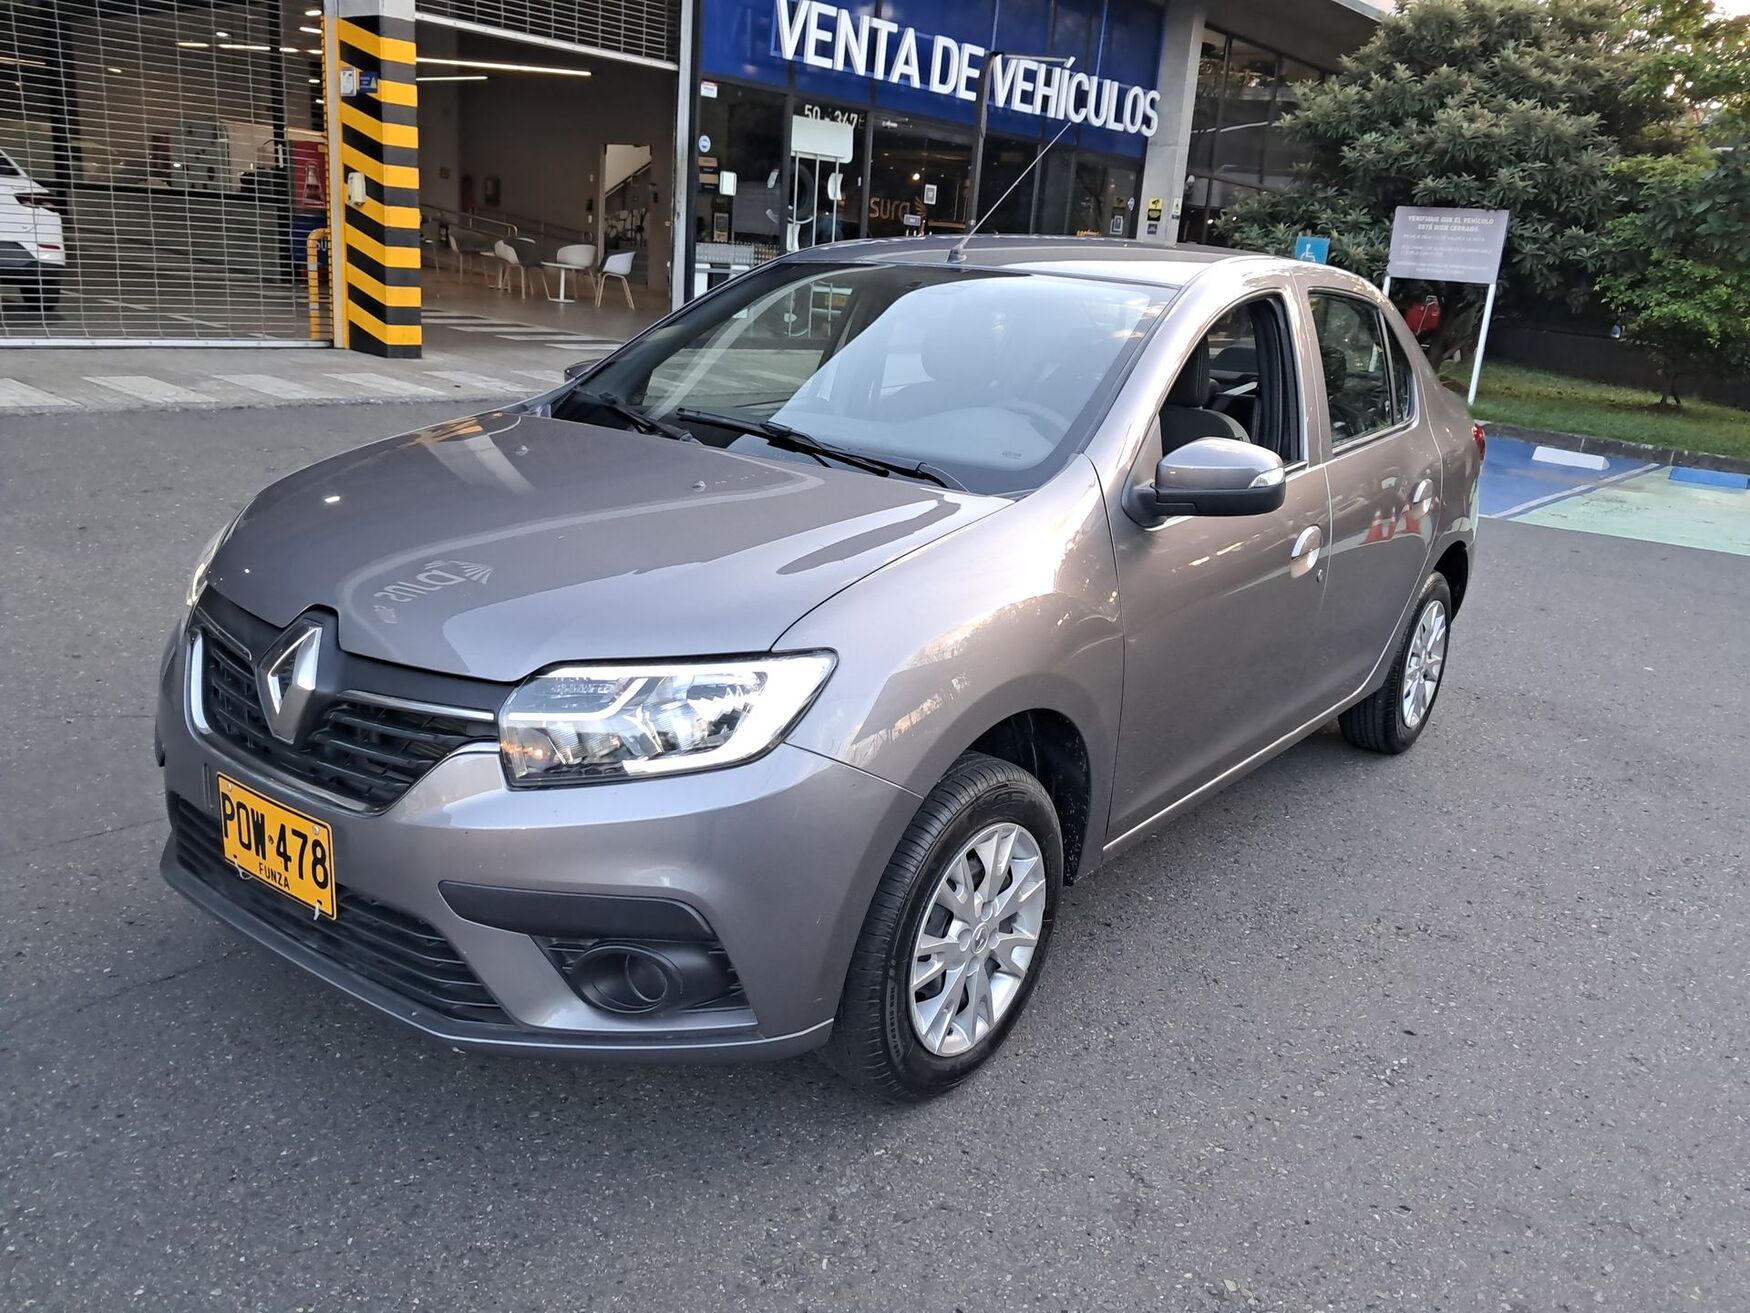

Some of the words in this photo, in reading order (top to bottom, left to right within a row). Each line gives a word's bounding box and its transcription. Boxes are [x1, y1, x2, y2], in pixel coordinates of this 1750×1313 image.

[776, 0, 921, 89] VENTA
[929, 35, 985, 102] DE
[993, 55, 1161, 137] VEHÍCULOS
[258, 862, 291, 891] FUNZA
